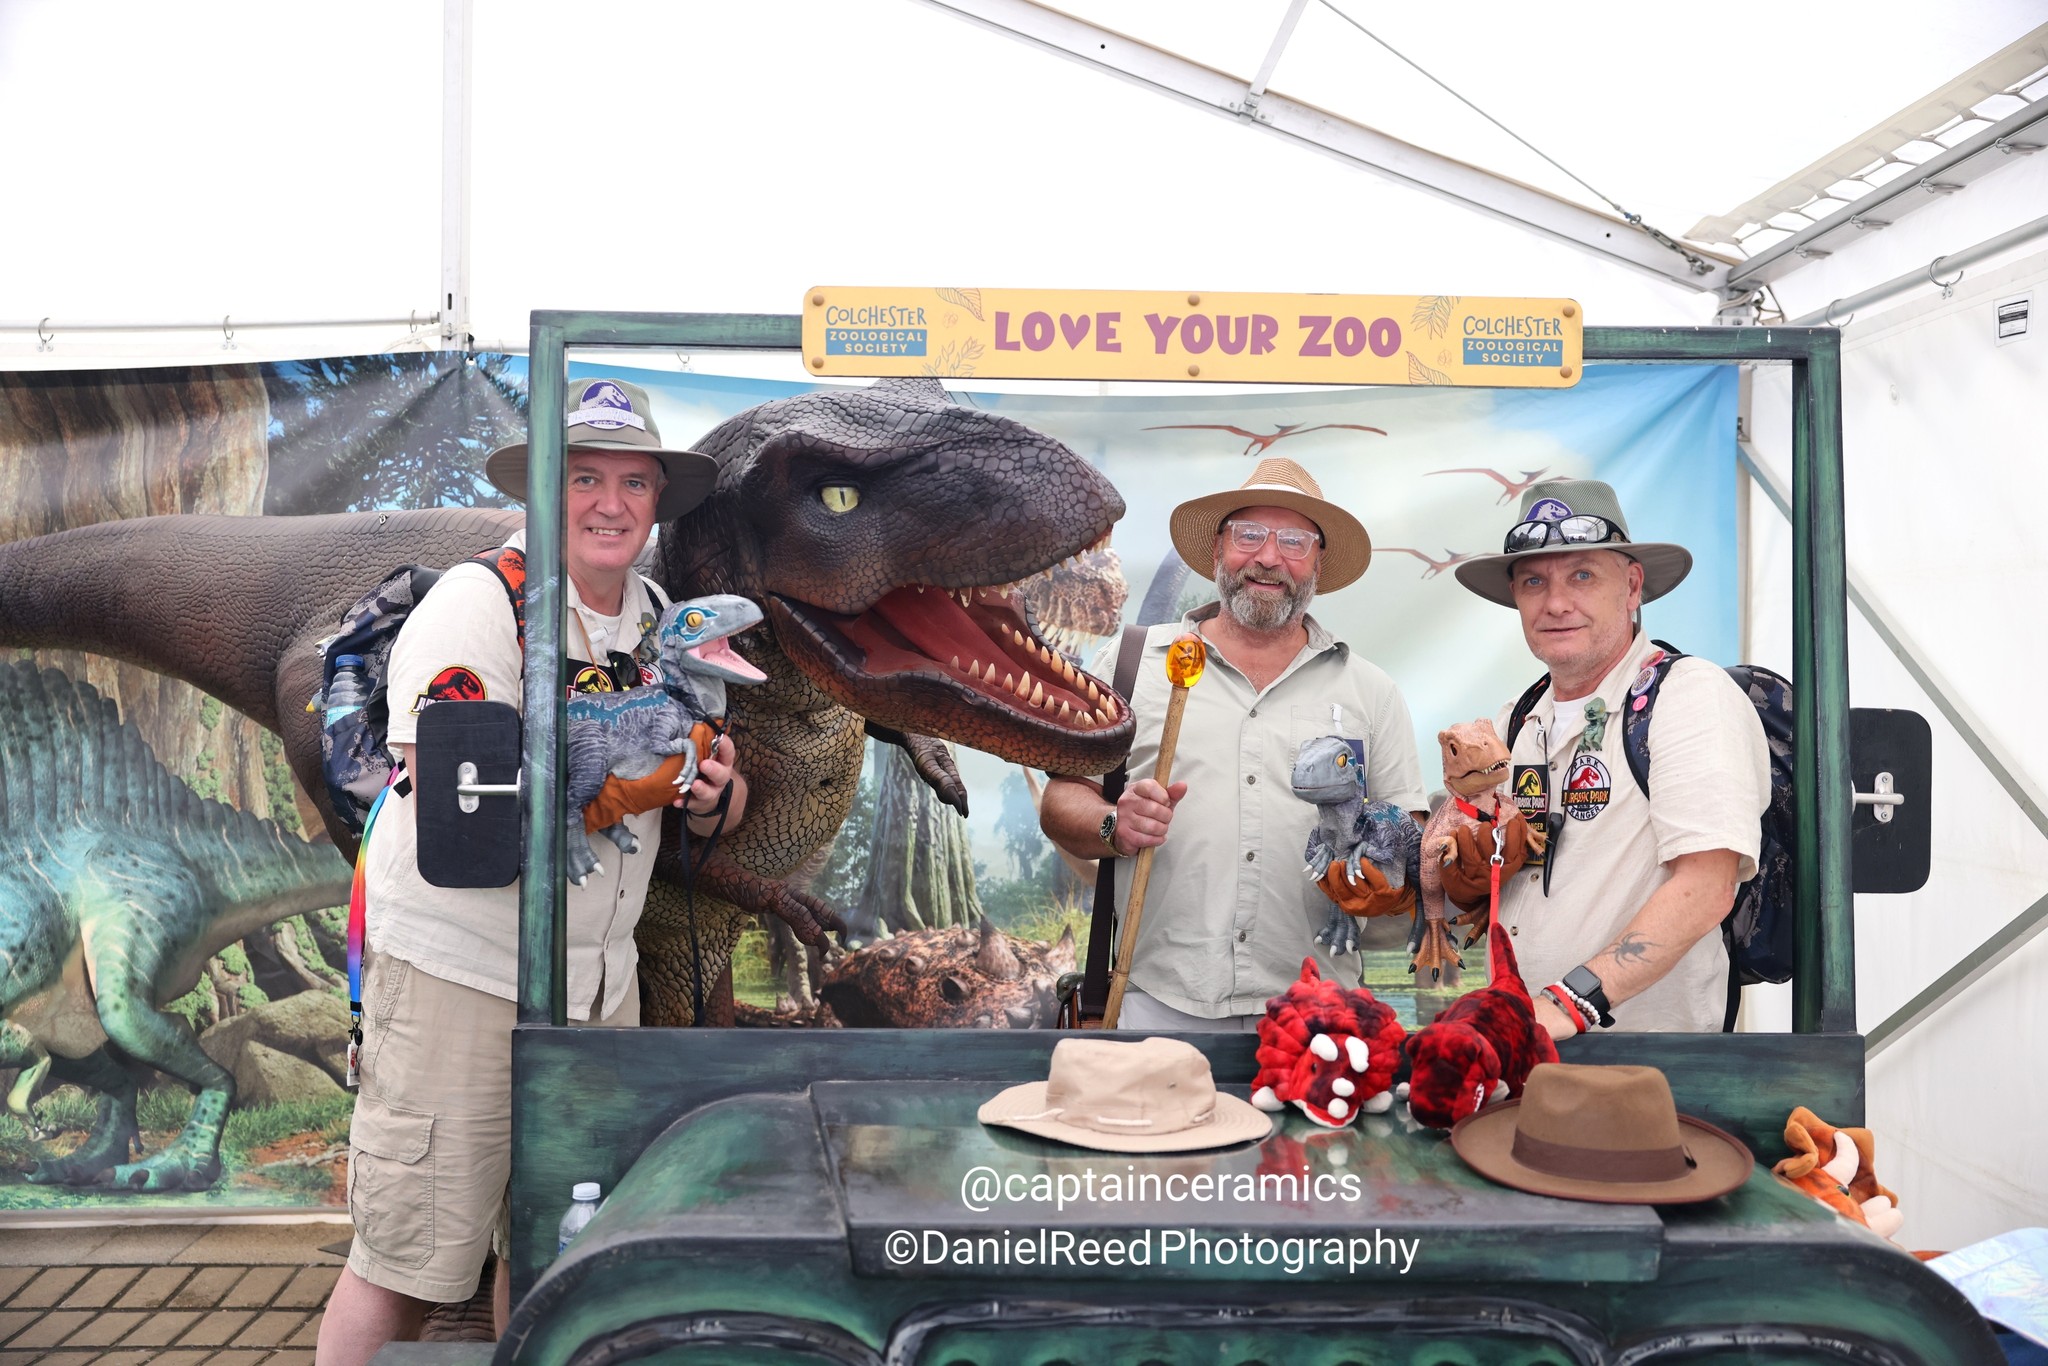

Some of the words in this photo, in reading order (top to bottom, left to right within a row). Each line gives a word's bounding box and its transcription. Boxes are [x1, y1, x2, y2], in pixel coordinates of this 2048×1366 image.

[826, 305, 927, 327] COLCHESTER
[1463, 315, 1563, 337] COLCHESTER
[829, 331, 923, 342] ZOOLOGICAL
[1144, 313, 1279, 355] YOUR
[1298, 315, 1401, 357] ZOO
[845, 343, 908, 354] SOCIETY
[1467, 340, 1559, 352] ZOOLOGICAL
[1482, 353, 1544, 364] SOCIETY
[1572, 757, 1599, 769] PARK
[1590, 790, 1608, 803] PARK
[1570, 805, 1601, 819] RANGER
